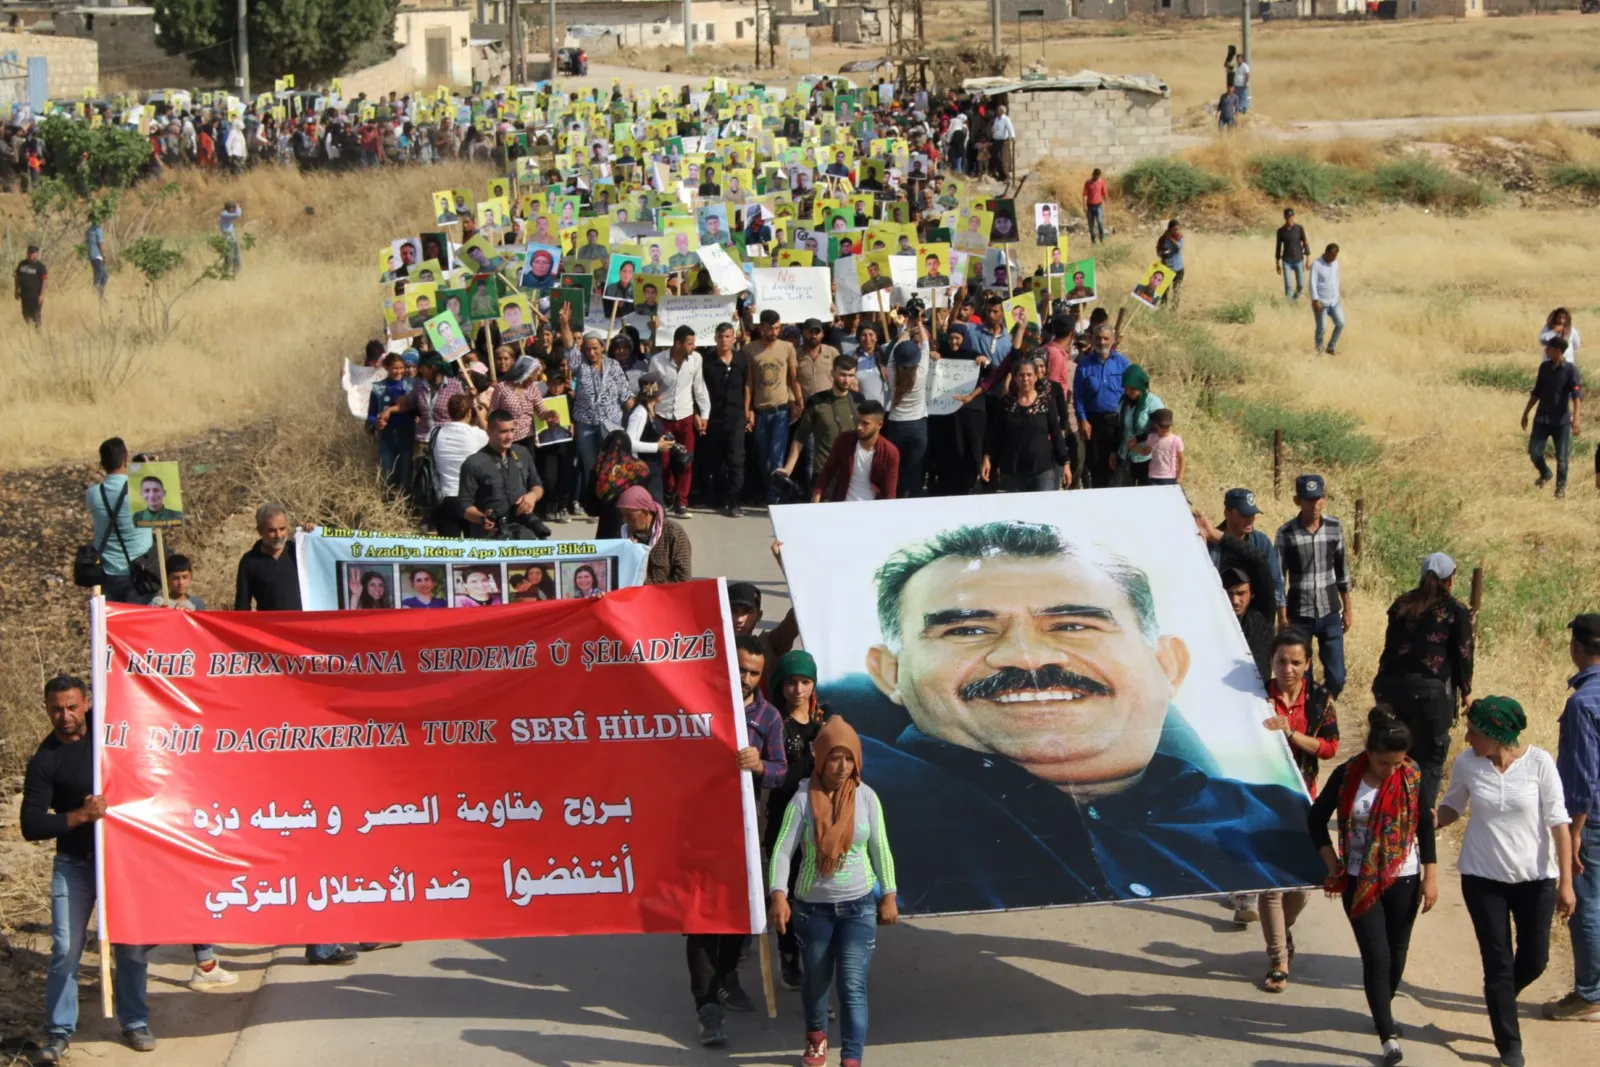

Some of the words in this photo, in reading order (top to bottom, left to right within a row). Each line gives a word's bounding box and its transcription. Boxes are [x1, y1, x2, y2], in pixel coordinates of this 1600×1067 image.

[351, 541, 363, 557] Û
[366, 544, 420, 559] Azadiya
[469, 546, 496, 560] Apo
[498, 545, 555, 559] Misoger
[557, 542, 596, 556] Bikin
[207, 650, 405, 677] BERXWEDANA
[418, 640, 536, 672] SERDEMÊ
[549, 639, 570, 666] Û
[581, 629, 716, 672] ŞÊLADİZÊ
[213, 719, 408, 753] DAGİRKERİYA
[422, 719, 496, 745] TURK
[510, 710, 588, 744] SERÎ
[597, 708, 713, 741] HİLDİN
[193, 802, 240, 837] دزه
[250, 799, 318, 837] شيله
[324, 804, 342, 835] و
[357, 793, 440, 834] العصر
[456, 791, 544, 828] مقاومة
[563, 795, 633, 827] بروح
[306, 865, 416, 912] الأحتلال
[424, 869, 471, 901] ضد
[501, 842, 635, 907] أنتفضوا
[205, 874, 297, 919] التركي
